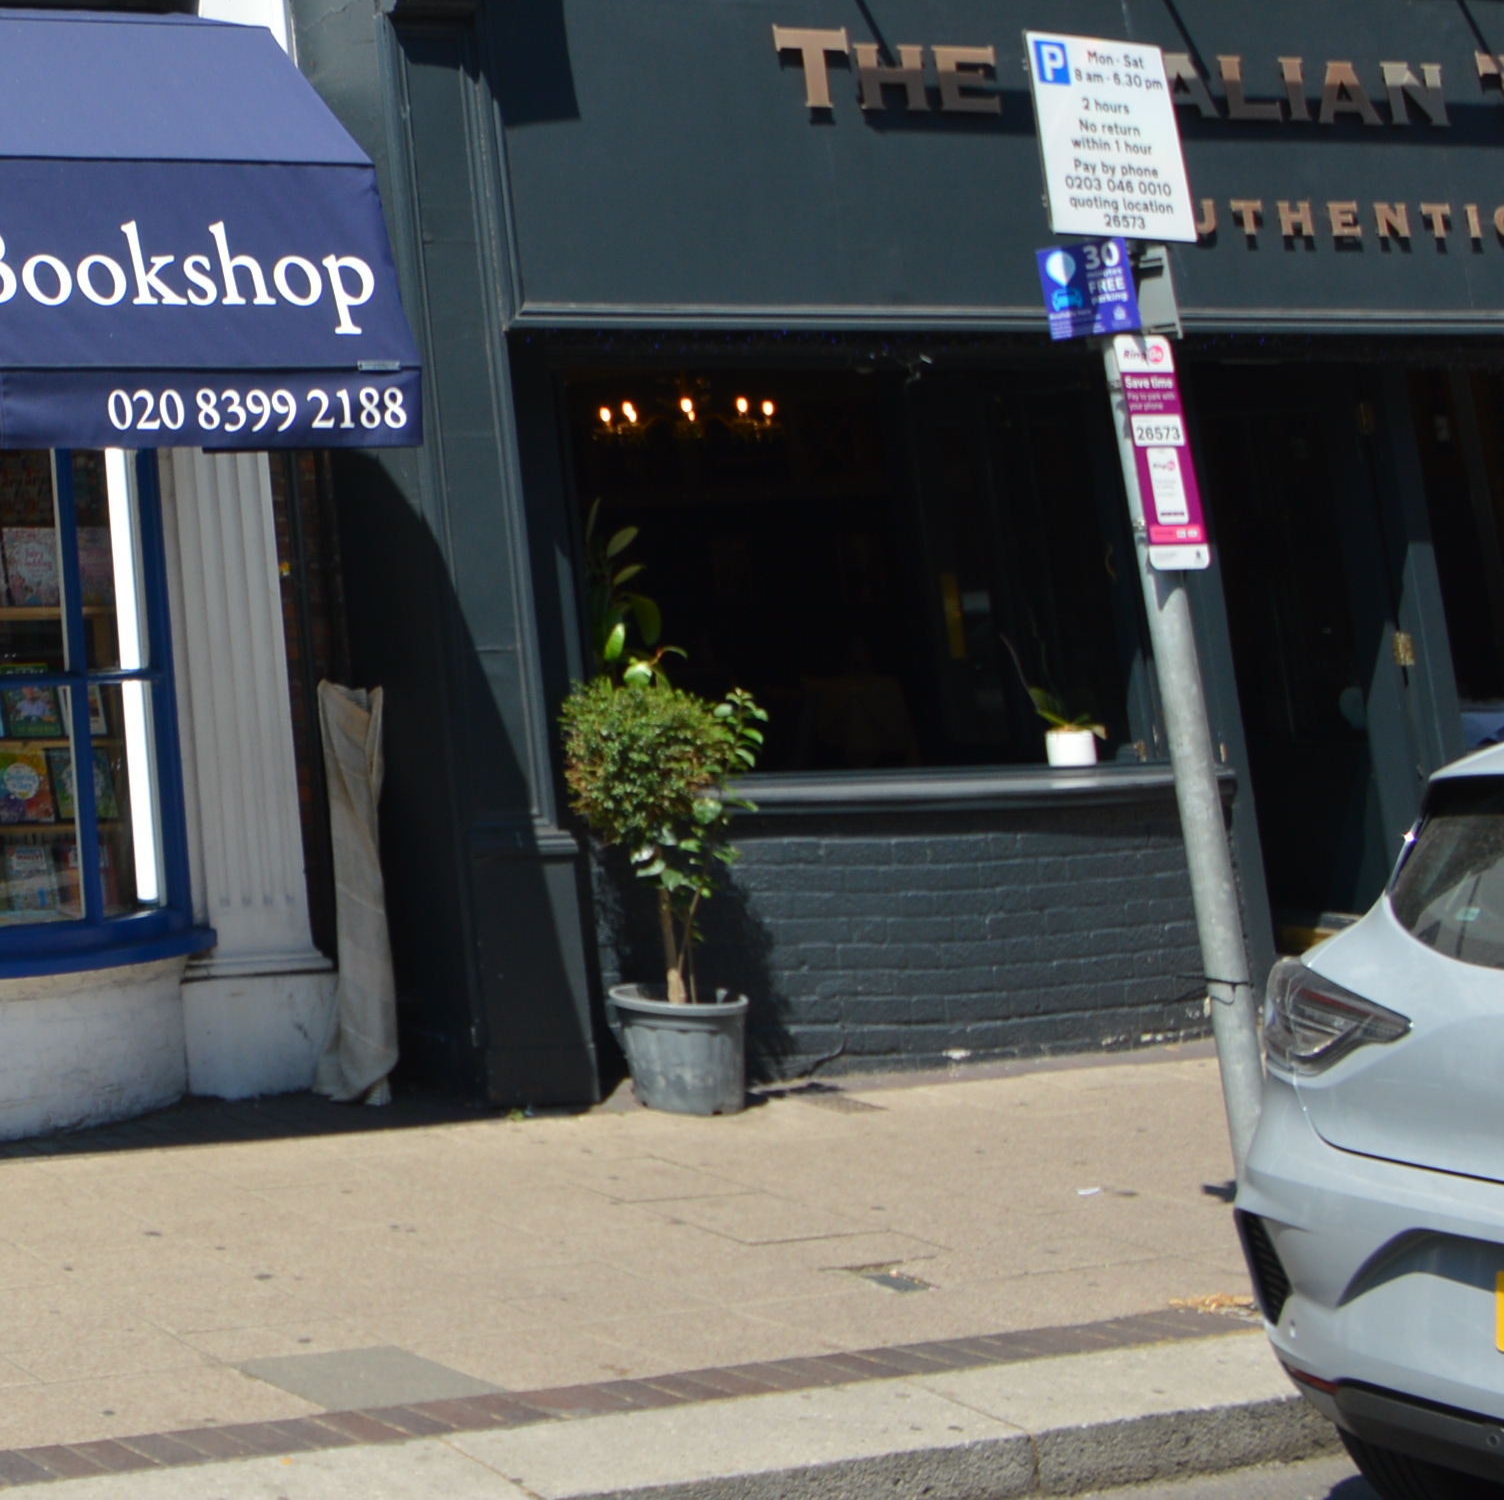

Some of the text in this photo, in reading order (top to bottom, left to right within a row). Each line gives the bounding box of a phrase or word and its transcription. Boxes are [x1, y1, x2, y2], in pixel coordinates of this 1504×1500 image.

[1087, 50, 1114, 66] Mon
[1123, 54, 1145, 70] Sat
[772, 23, 1002, 116] THE
[1163, 53, 1450, 127] ALIAN
[1074, 69, 1082, 82] 8
[1086, 73, 1104, 84] am
[1113, 73, 1142, 88] 6.30
[1145, 78, 1163, 91] pm
[1081, 97, 1130, 115] 2 hours
[1078, 119, 1141, 136] No return
[1071, 137, 1152, 155] within 1 hour
[1073, 158, 1159, 179] Pay by phone
[1065, 175, 1172, 197] 0203 046 0010
[1069, 195, 1174, 215] quoting location
[1103, 214, 1146, 230] 26573
[1082, 241, 1120, 271] 30
[1086, 266, 1123, 280] minutes
[1088, 275, 1127, 295] FREE
[1090, 290, 1129, 307] parking
[1124, 376, 1173, 390] Save time
[1127, 391, 1175, 402] Pay to park with
[107, 386, 408, 433] 020 8399 2188
[1129, 402, 1164, 412] your phone
[1136, 426, 1181, 441] 26573
